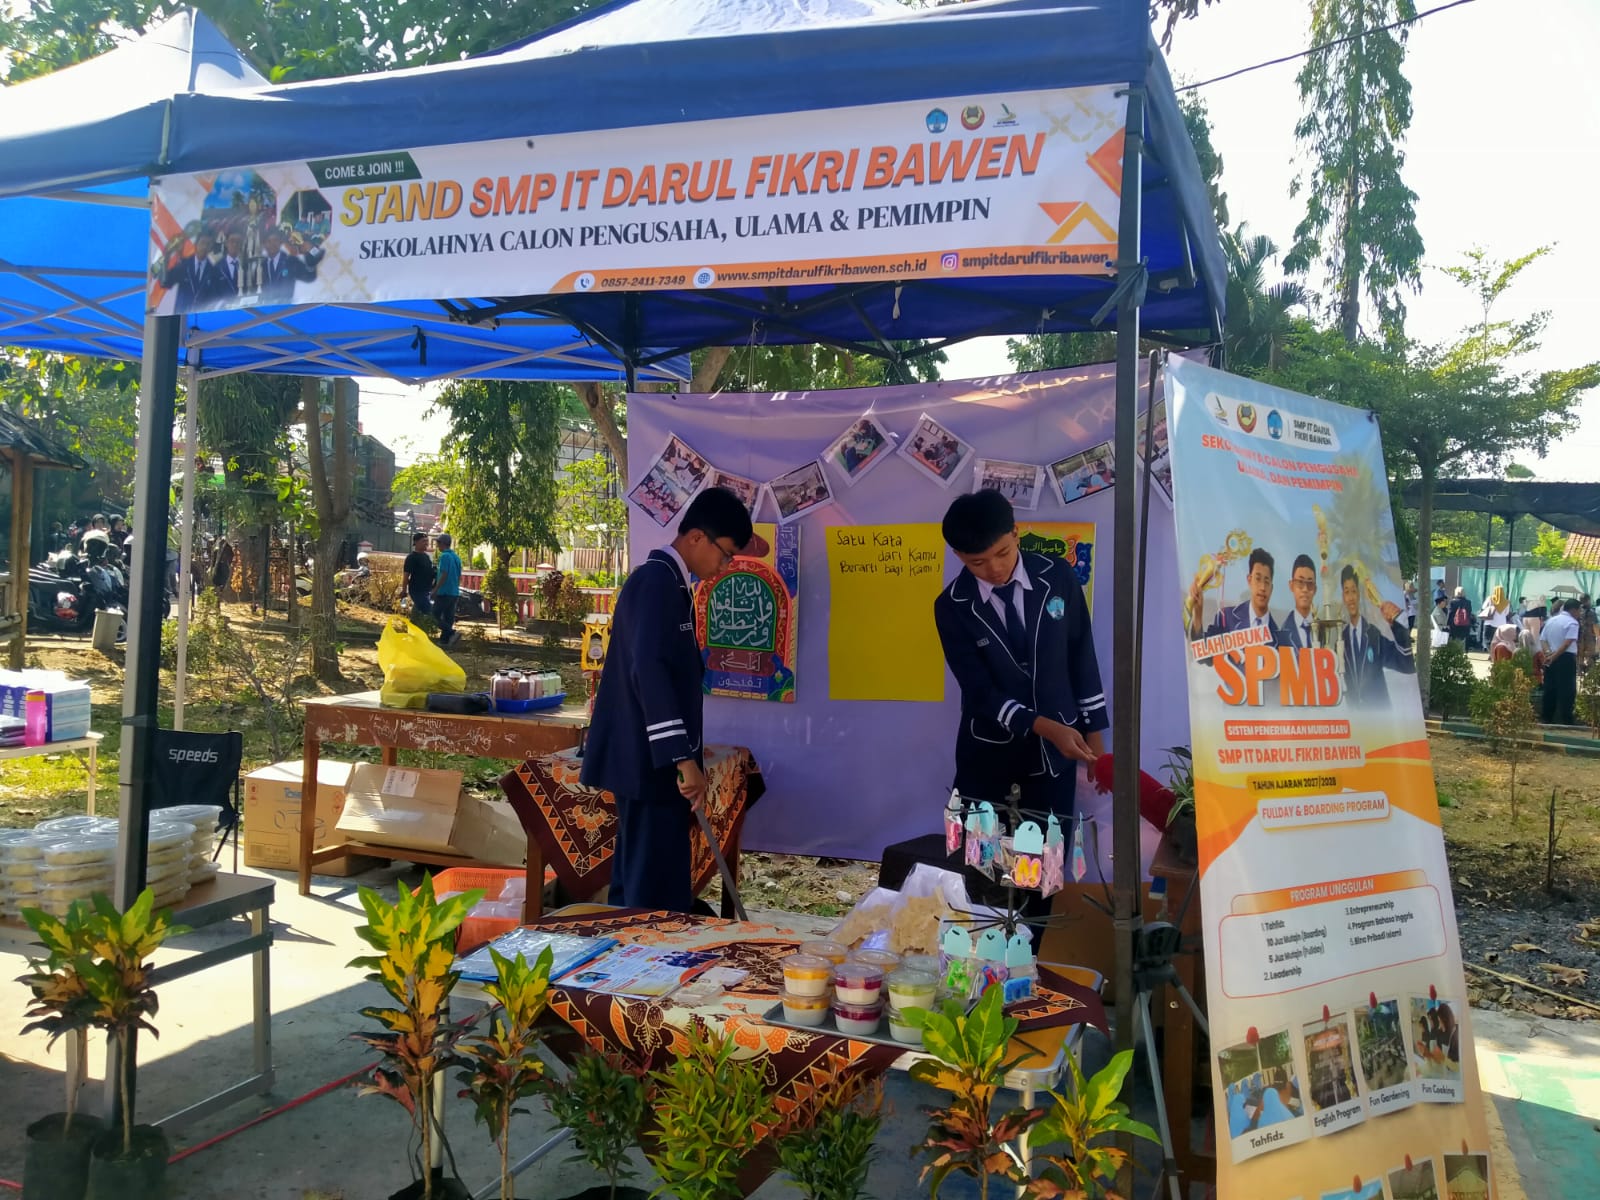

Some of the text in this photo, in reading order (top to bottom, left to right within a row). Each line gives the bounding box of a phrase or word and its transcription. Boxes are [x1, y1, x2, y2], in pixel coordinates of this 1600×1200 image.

[325, 160, 405, 180] COME & JOIN !!!
[340, 132, 1046, 227] STAND SMP IT DARUL FIKRI BAWEN
[359, 197, 991, 260] SEKOLAHNYA CALON PENGUSAHA, ULAMA & PEMIMPIN
[962, 250, 1109, 268] smpitdarulfikribawen
[717, 259, 927, 282] www.smpitdarulfikribawen.sch.id
[601, 275, 686, 288] 0857-2411-7349
[1293, 419, 1307, 430] SMP
[1294, 430, 1332, 446] FIKRI BAWEN
[1264, 456, 1296, 472] CALON
[1291, 476, 1343, 492] PEMIMPIN
[837, 530, 902, 548] Satu Kata
[878, 547, 937, 562] dari Kamu
[840, 560, 877, 575] Berarti
[885, 564, 903, 577] bagi
[1192, 626, 1271, 658] TELAH DIBUKA
[1213, 645, 1343, 707] SPMB
[1228, 724, 1349, 736] SISTEM PENERIMAAN MURID BARU
[168, 746, 218, 763] speeds
[1218, 745, 1361, 764] SMP IT DARUL FIKRI BAWEN
[1252, 780, 1275, 791] TAHUN
[1276, 778, 1303, 789] AJARAN
[1262, 799, 1385, 819] FULLDAY & BOARDING PROGRAM
[1291, 880, 1374, 902] PROGRAM UNGGULAN
[1368, 1088, 1410, 1106] Fun Gardening
[1422, 1083, 1456, 1098] Fun Cooking
[1314, 1104, 1361, 1128] English Program
[1250, 1130, 1285, 1149] Tahfidz
